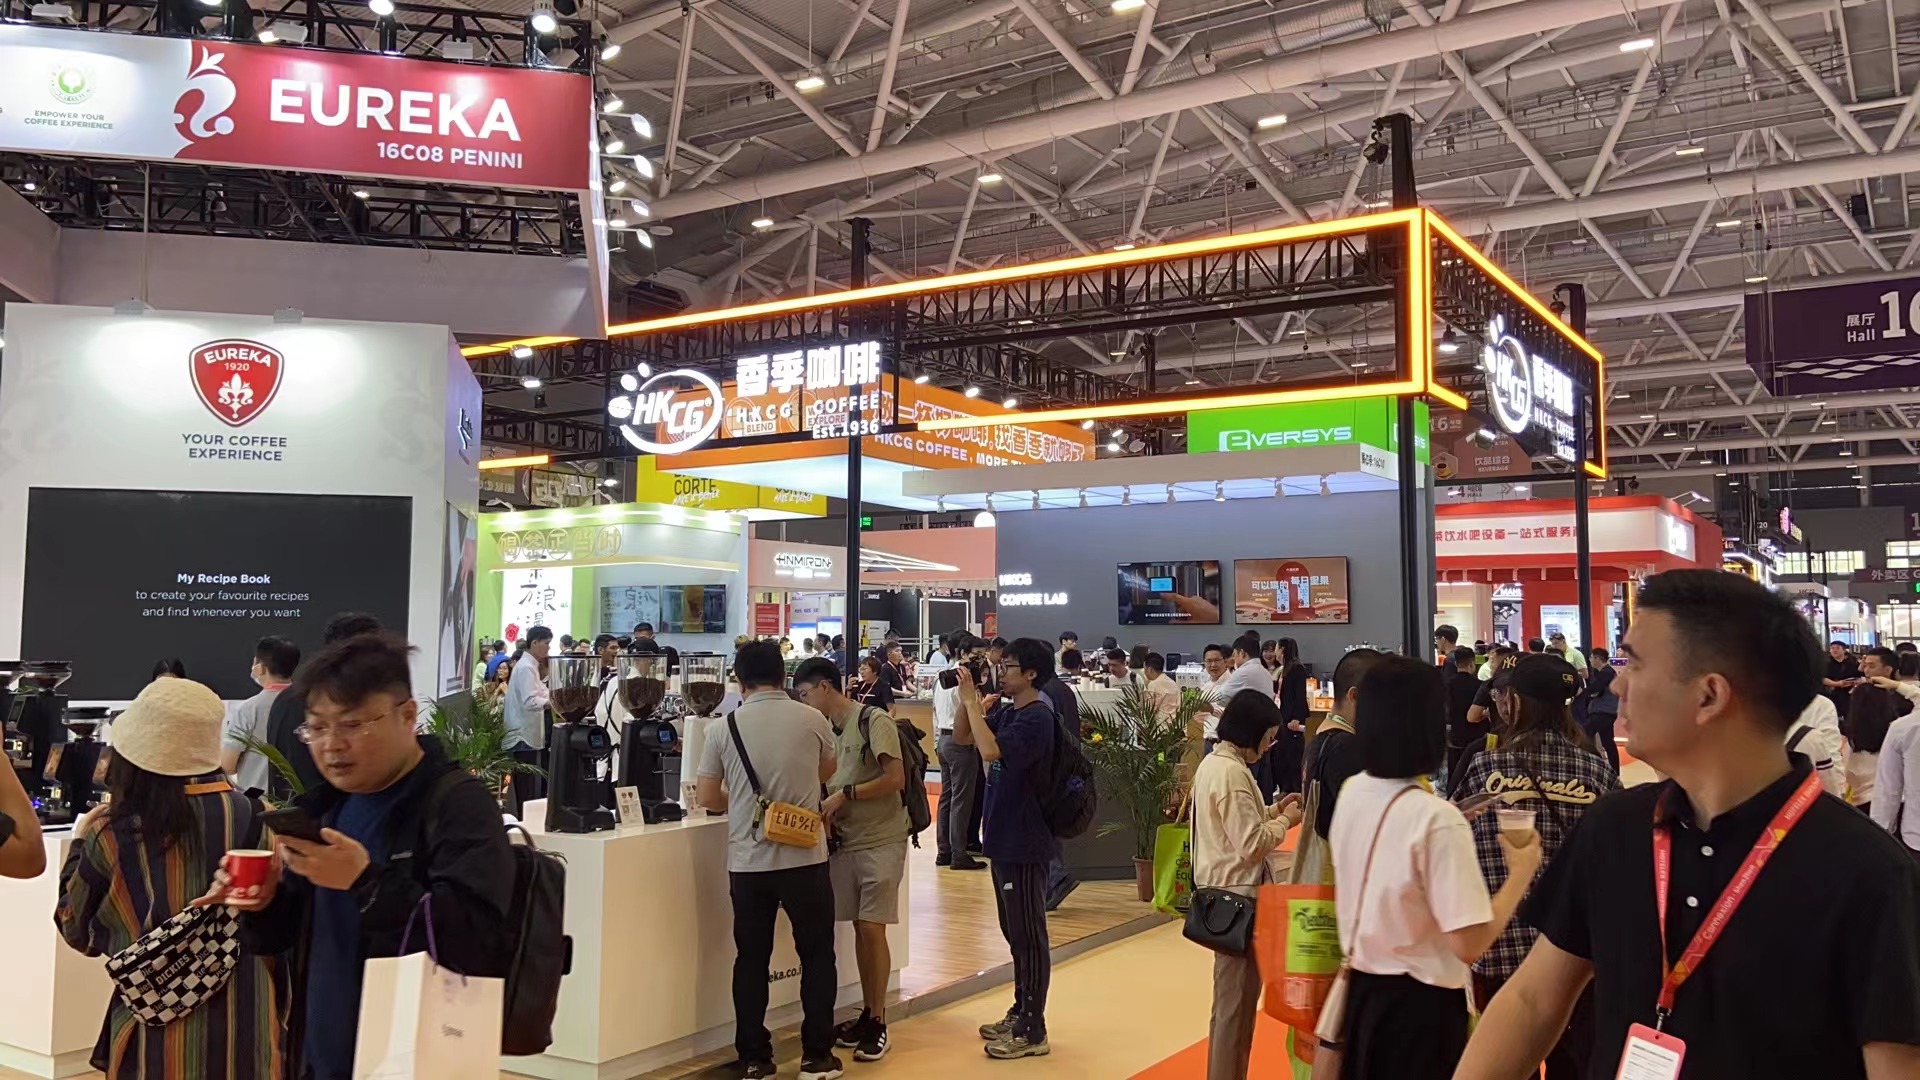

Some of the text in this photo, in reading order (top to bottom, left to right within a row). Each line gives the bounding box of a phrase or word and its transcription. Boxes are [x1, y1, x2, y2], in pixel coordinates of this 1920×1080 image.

[34, 110, 105, 121] EMPOWER YOUR
[270, 79, 521, 142] EUREKA
[24, 117, 113, 130] COFFEE EXPERIENCE
[377, 142, 522, 169] 16C08 PENINI
[1846, 312, 1875, 328] 展厅
[1847, 328, 1875, 342] Hall
[203, 348, 271, 368] EUREKA
[224, 363, 250, 371] 1920
[736, 341, 880, 397] 香季咖啡
[813, 393, 879, 415] COFFEE
[632, 390, 705, 434] HKCG
[746, 421, 774, 433] BLEND
[808, 413, 846, 427] EXPLORE
[813, 418, 880, 439] Est.1936
[182, 434, 288, 447] YOUR COFFEE
[874, 433, 913, 449] HKCG
[189, 448, 282, 461] EXPERIENCE
[674, 478, 717, 495] CORTE
[177, 574, 271, 585] My Recipe Book
[1871, 569, 1909, 580] 外卖区
[136, 591, 309, 602] to create your favourite recipes
[1000, 593, 1068, 606] COFFEE LAB
[142, 607, 301, 619] and find whenever you want
[154, 953, 191, 985] DICKIES
